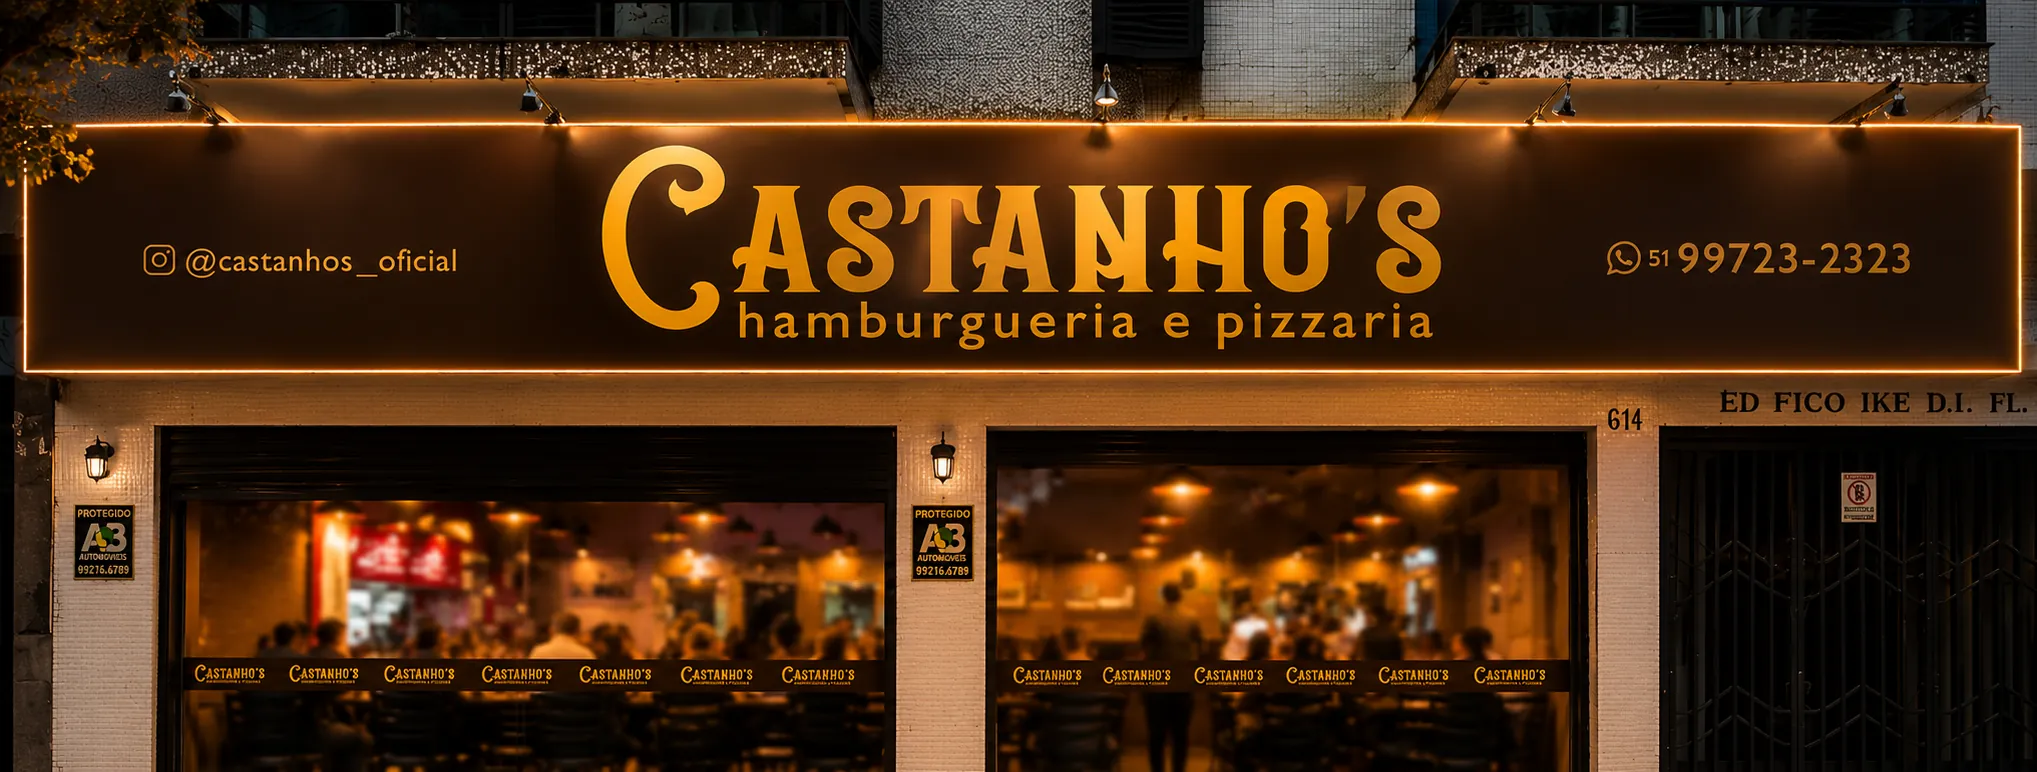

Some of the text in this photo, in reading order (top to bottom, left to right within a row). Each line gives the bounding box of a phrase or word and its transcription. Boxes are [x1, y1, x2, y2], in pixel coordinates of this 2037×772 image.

[1648, 242, 1911, 274] 51 99723-2323
[739, 301, 1433, 351] hamburgueria e pizzaria
[1773, 391, 1846, 413] FICO
[1861, 392, 1910, 413] IKE
[1989, 392, 2028, 413] FL.
[1607, 408, 1643, 431] 614
[77, 508, 131, 518] PROTEGIDO
[915, 509, 971, 519] PROTEGIDO
